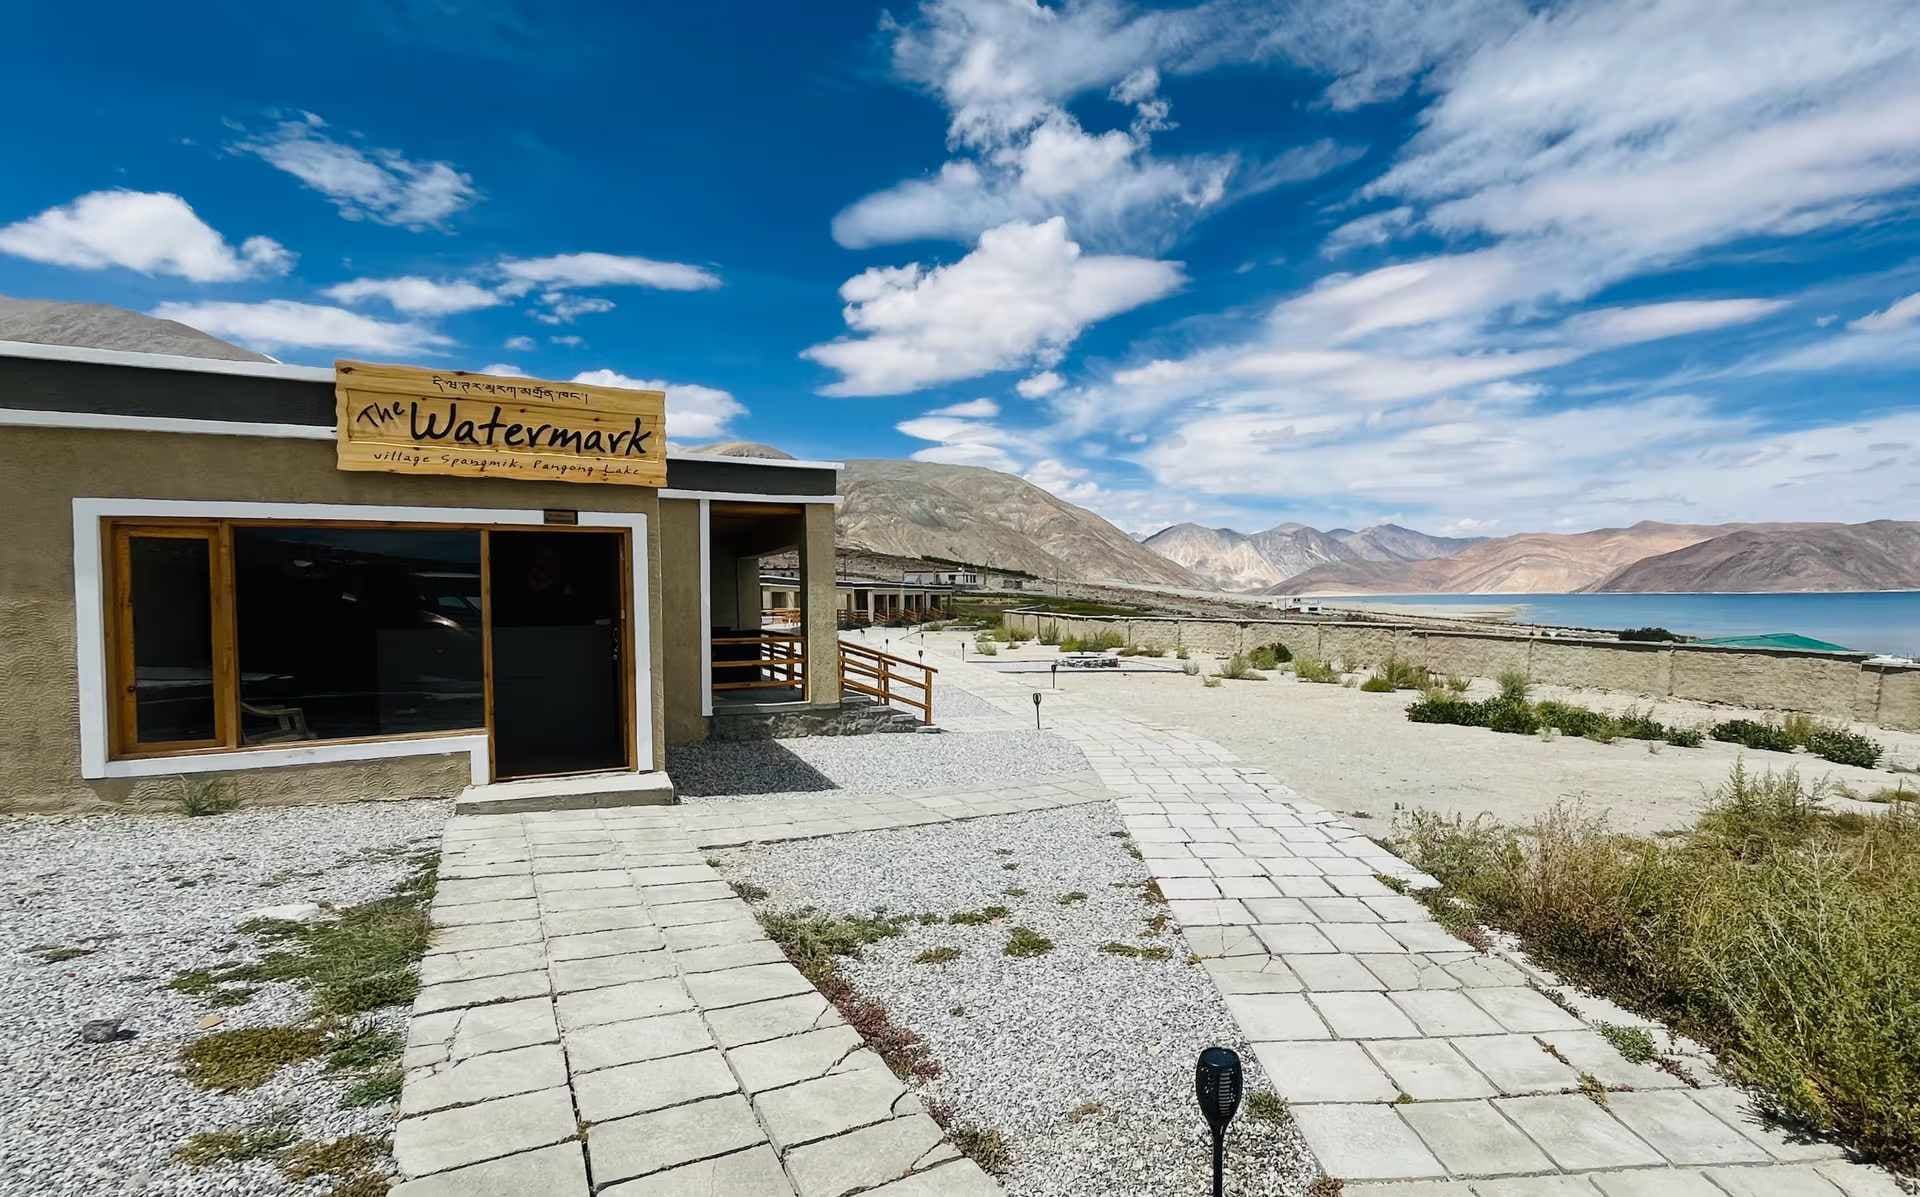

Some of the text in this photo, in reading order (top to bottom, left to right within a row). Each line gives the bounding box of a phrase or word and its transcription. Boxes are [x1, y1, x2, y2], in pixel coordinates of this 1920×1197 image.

[356, 401, 651, 456] The Watermark
[532, 460, 595, 477] Pangong
[604, 465, 641, 477] Lake
